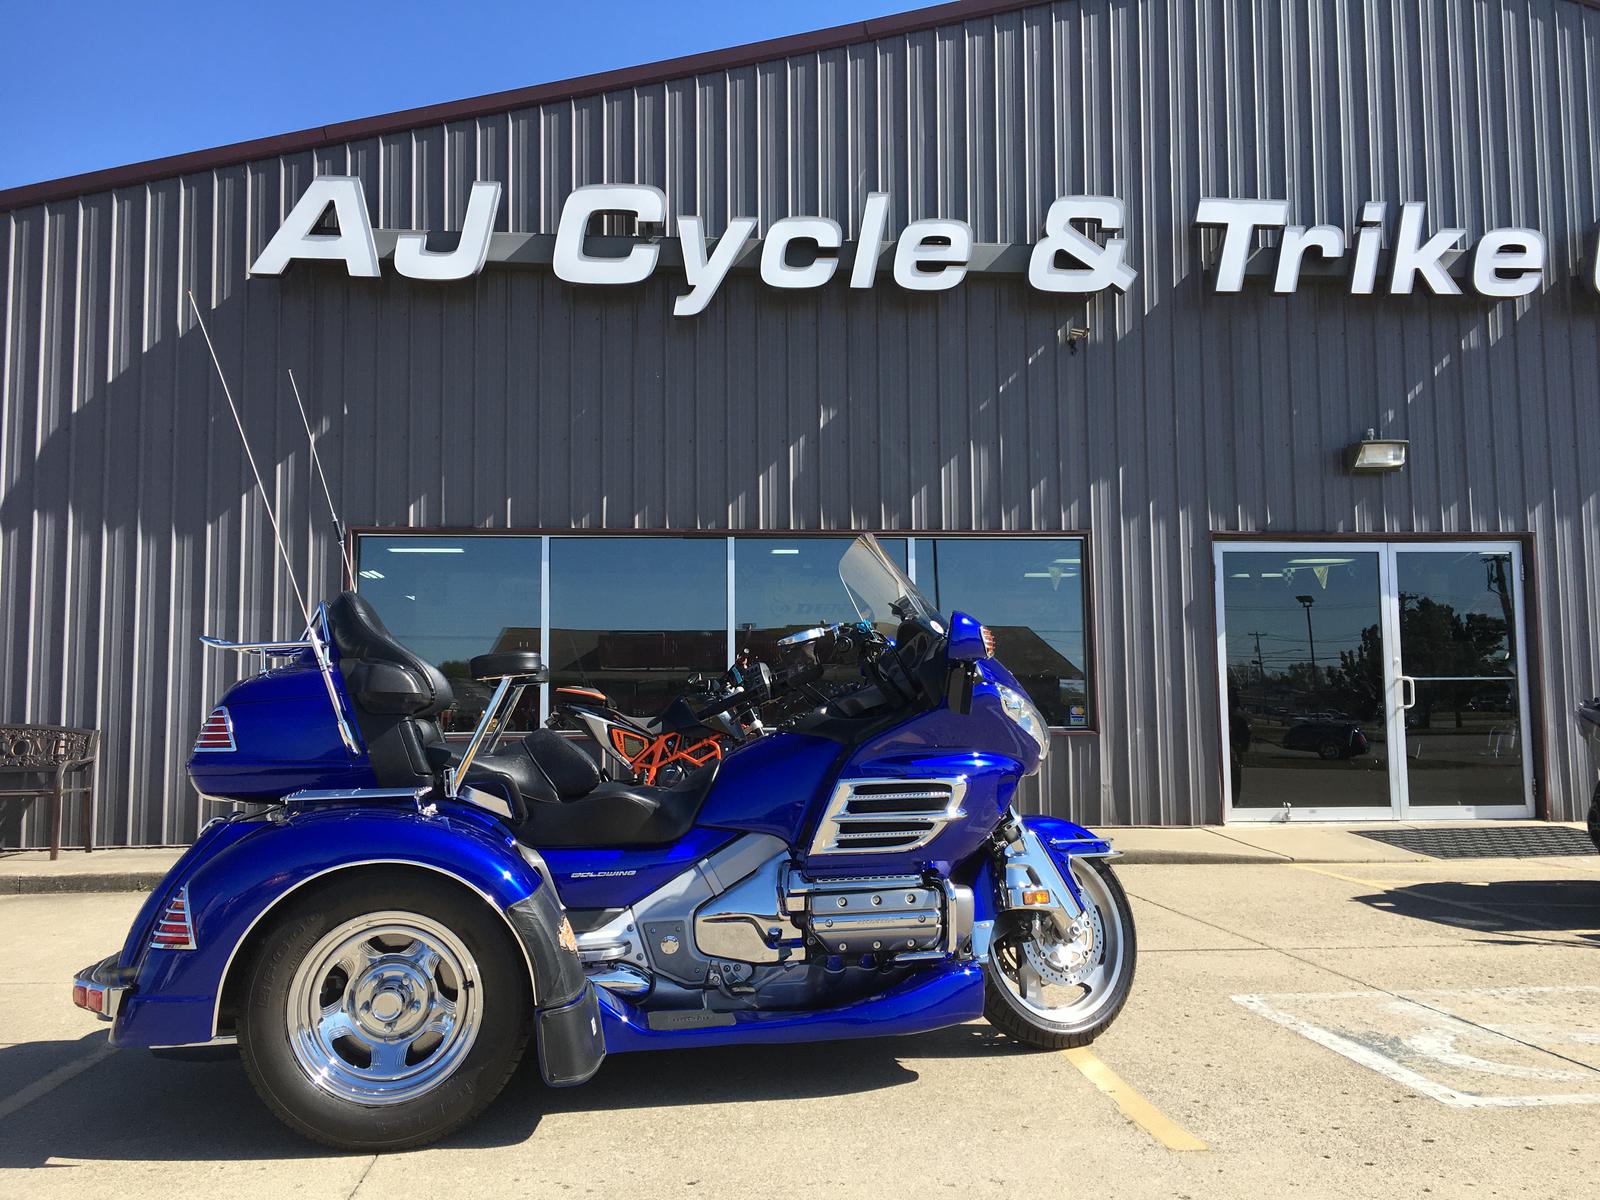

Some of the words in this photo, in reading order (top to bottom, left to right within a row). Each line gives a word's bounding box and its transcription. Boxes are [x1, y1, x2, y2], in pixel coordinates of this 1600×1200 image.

[249, 175, 502, 281] AJ
[552, 183, 974, 317] Cycle
[1028, 194, 1138, 296] &
[1195, 197, 1547, 298] Trike
[571, 870, 637, 878] GOLDWING
